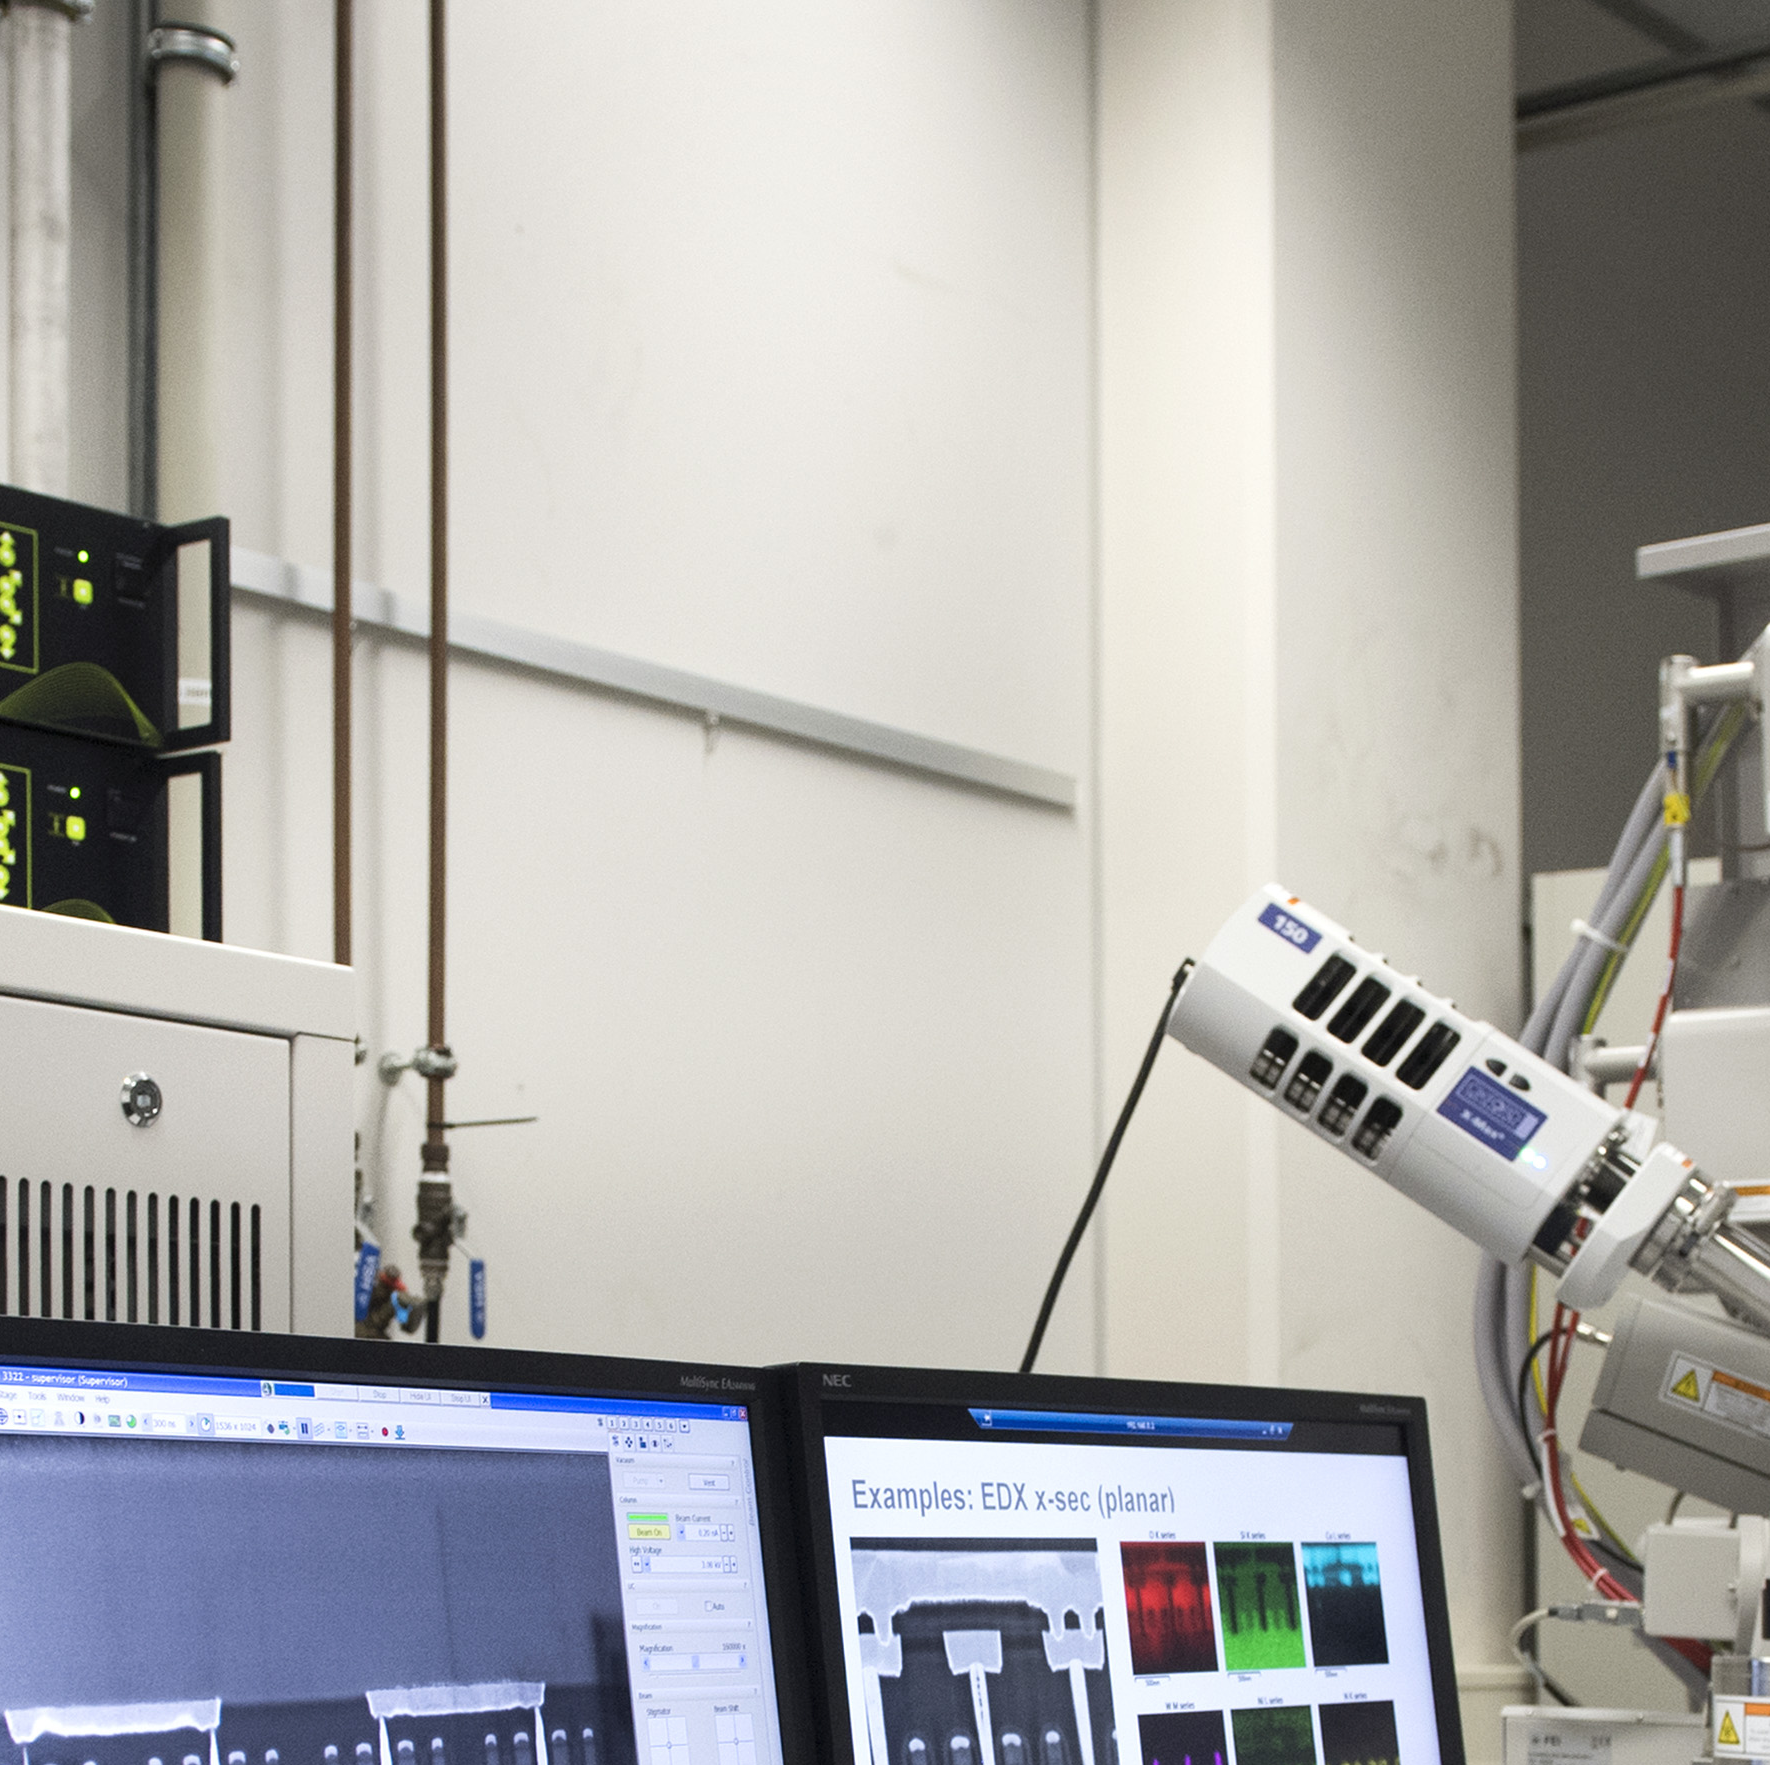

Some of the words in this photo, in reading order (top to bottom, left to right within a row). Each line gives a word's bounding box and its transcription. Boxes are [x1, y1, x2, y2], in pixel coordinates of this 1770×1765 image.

[1274, 914, 1309, 945] 150
[3, 1371, 24, 1382] 3322
[32, 1373, 75, 1385] supervisor
[78, 1375, 128, 1388] (Supervisor)
[822, 1374, 852, 1388] NEC
[28, 1391, 47, 1402] Tools
[57, 1392, 85, 1403] Window
[95, 1394, 110, 1404] Help
[851, 1478, 974, 1517] Examples:
[980, 1481, 1029, 1512] EDX
[1035, 1487, 1091, 1513] x-sec
[1097, 1484, 1176, 1520] (planar)
[675, 1514, 691, 1523] Beam
[692, 1514, 711, 1523] Current
[637, 1528, 652, 1537] Beam
[1161, 1532, 1177, 1540] series
[1253, 1532, 1266, 1540] series
[1180, 1701, 1195, 1710] series
